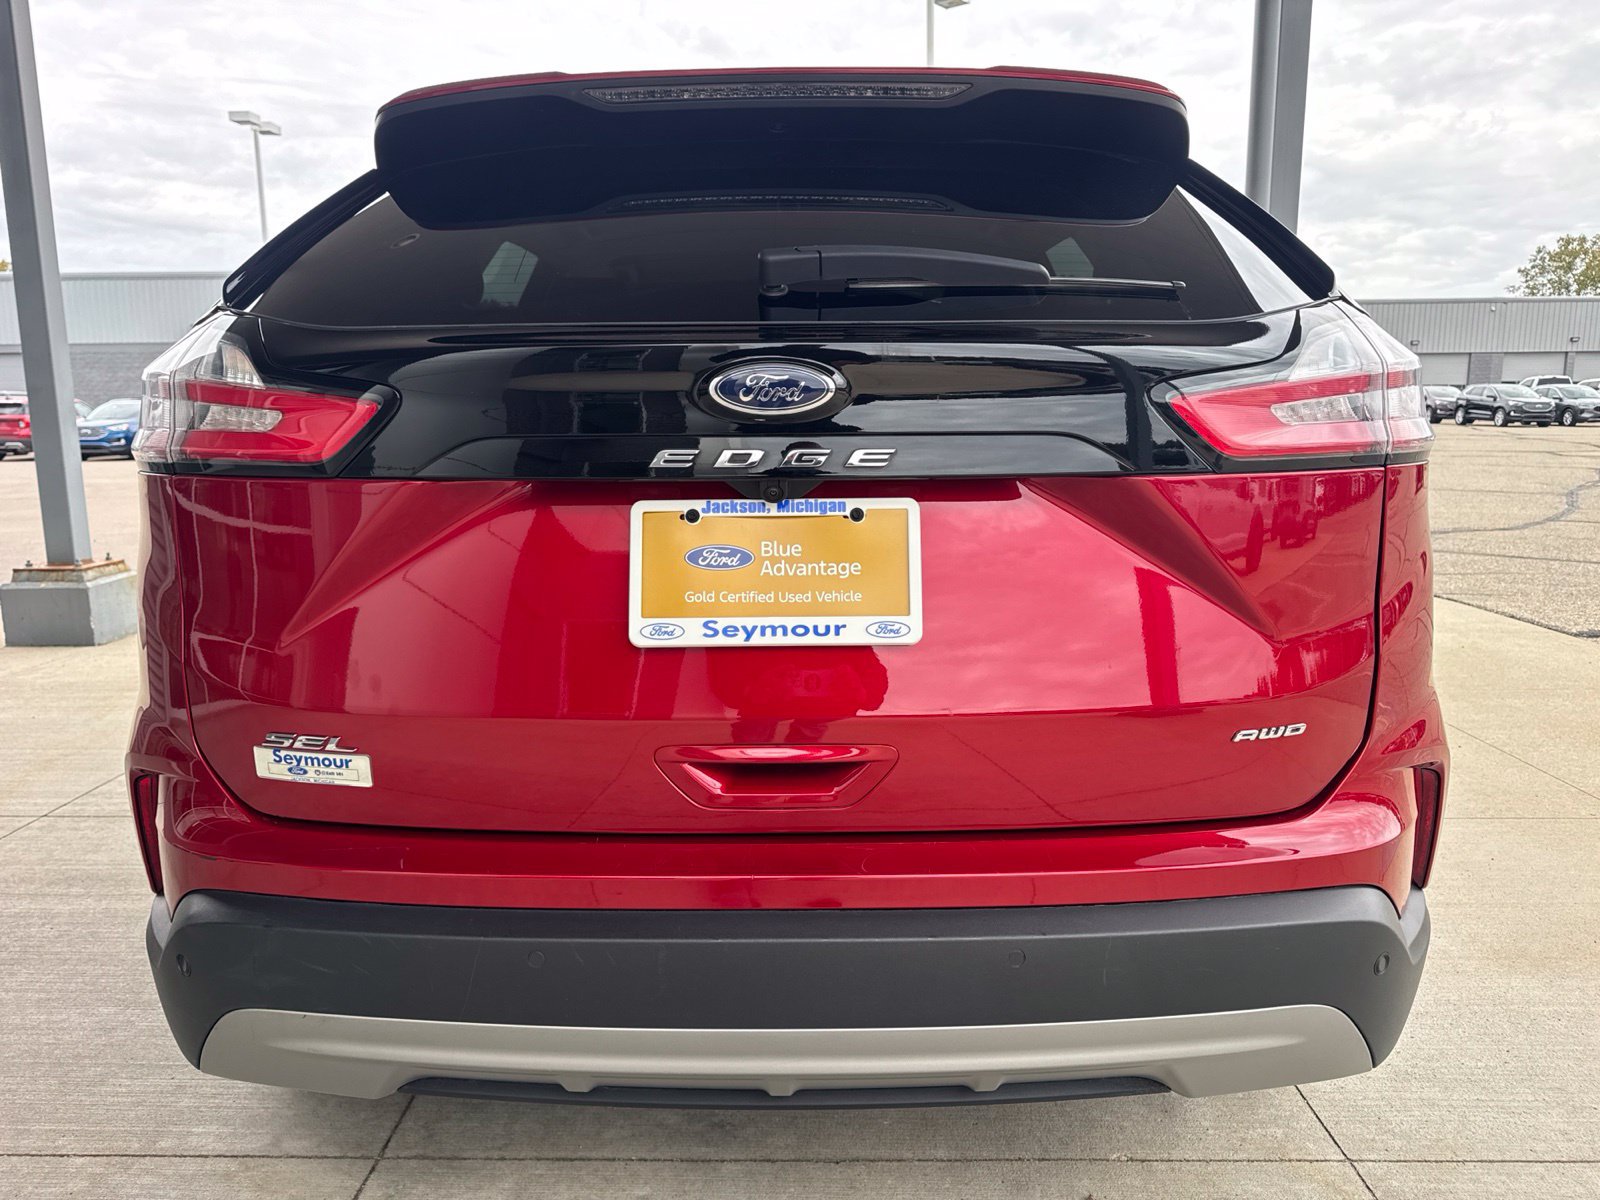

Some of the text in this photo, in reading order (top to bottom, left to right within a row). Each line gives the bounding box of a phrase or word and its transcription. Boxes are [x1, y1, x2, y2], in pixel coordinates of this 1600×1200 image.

[738, 373, 806, 402] Ford
[649, 449, 897, 468] EDGE
[701, 499, 847, 515] Jackson, Michigan
[698, 549, 741, 567] Ford
[760, 541, 802, 557] Blue
[760, 560, 862, 579] Advantage
[685, 590, 862, 603] Gold Certified Used Vehicle
[649, 625, 677, 638] Ford
[702, 620, 847, 642] Seymour
[874, 623, 902, 636] Ford
[261, 732, 358, 752] SEL
[1231, 723, 1307, 742] AWD
[272, 748, 352, 769] Seymour
